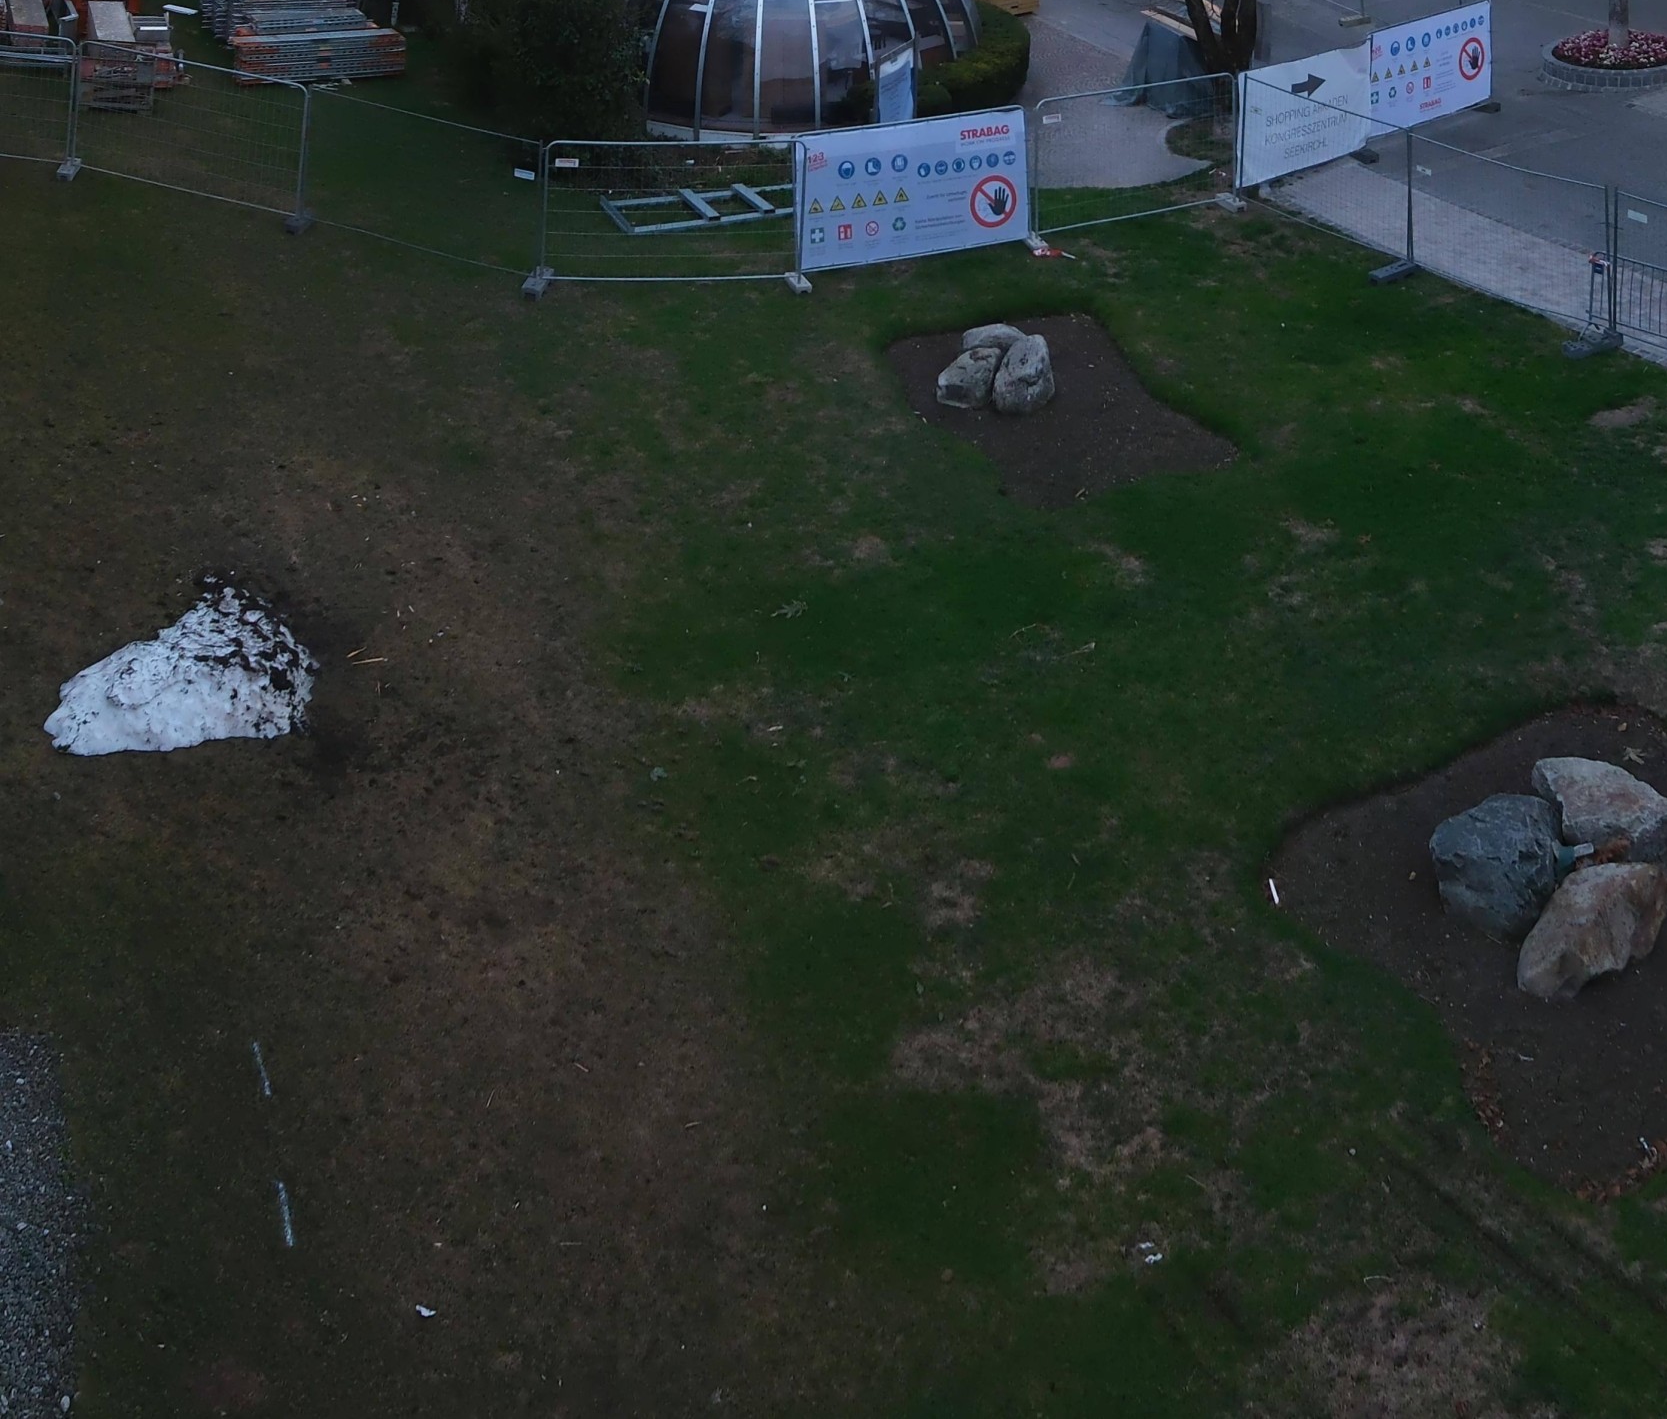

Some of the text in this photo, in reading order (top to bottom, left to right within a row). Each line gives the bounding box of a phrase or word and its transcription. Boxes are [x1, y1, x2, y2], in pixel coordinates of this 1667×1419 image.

[1265, 106, 1311, 127] SHOPPING
[960, 124, 1010, 141] STRABAG
[1264, 112, 1348, 146] KONGRESSZENTRUM
[1284, 137, 1329, 160] SEEKIRCHL
